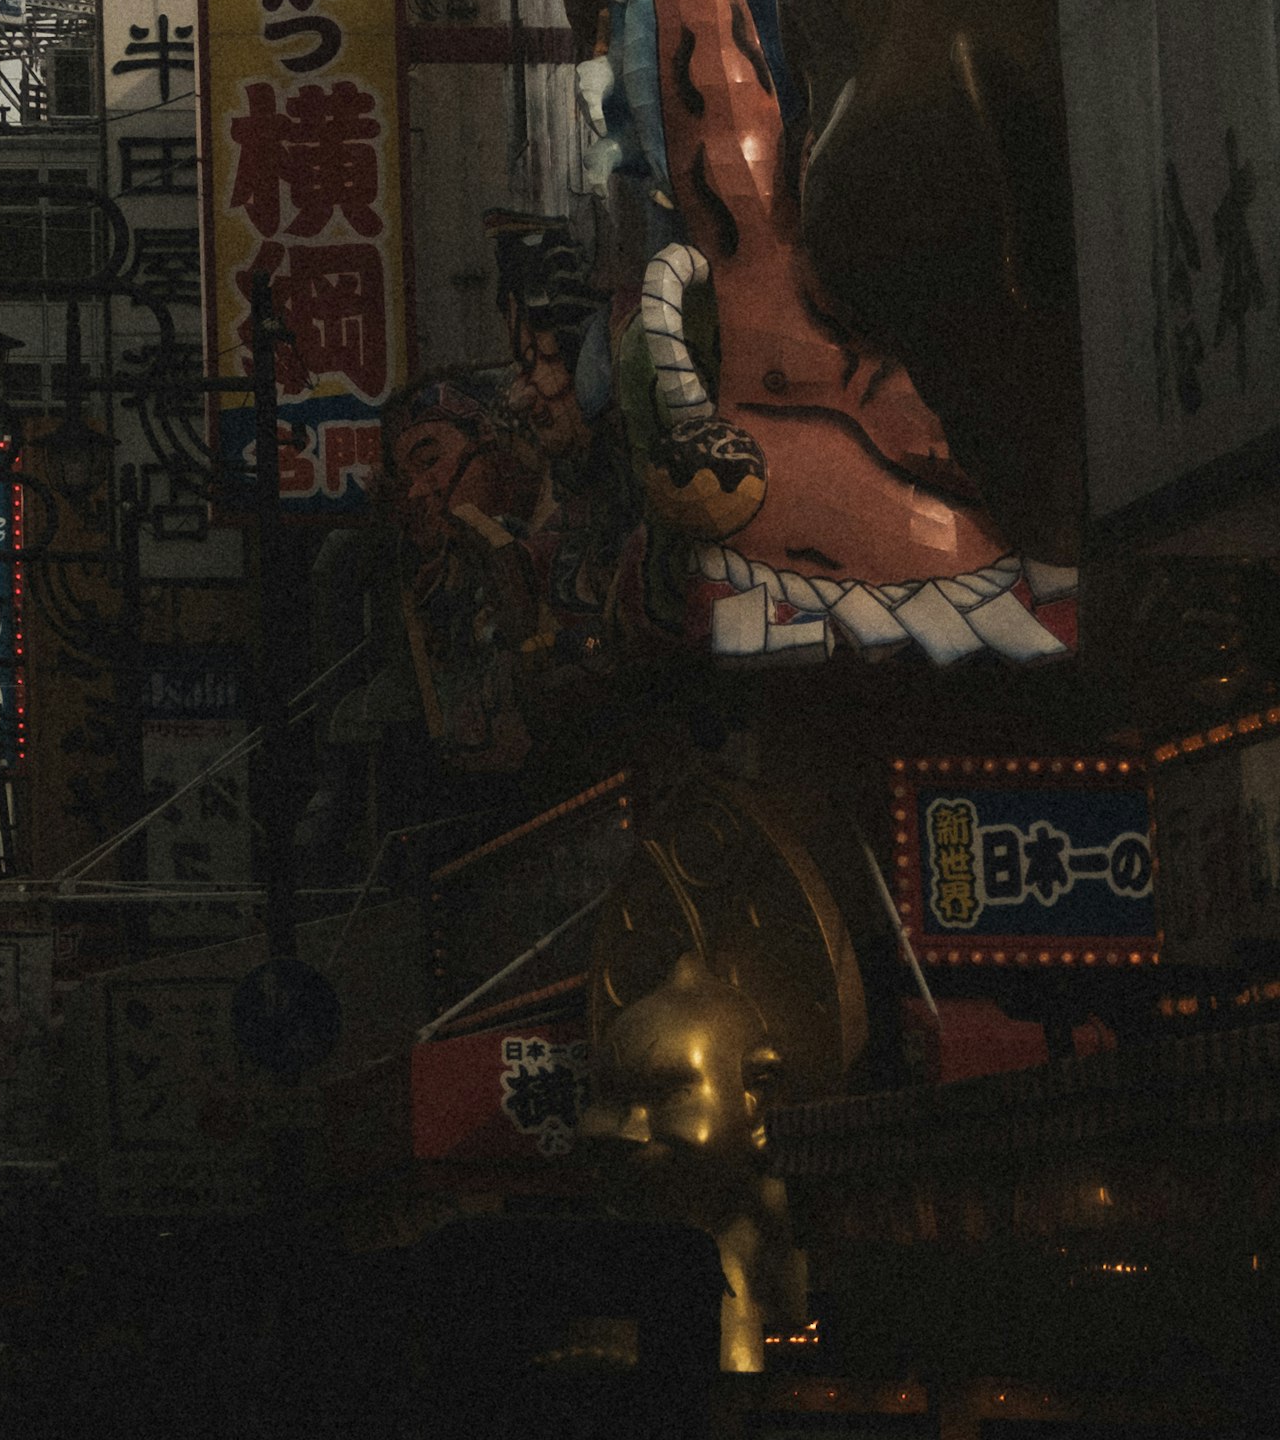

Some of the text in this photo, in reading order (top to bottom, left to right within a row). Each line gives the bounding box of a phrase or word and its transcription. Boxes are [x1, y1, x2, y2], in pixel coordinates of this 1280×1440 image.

[230, 82, 390, 402] 横綱
[933, 806, 977, 923] 新世界
[980, 826, 1153, 902] 日本一の
